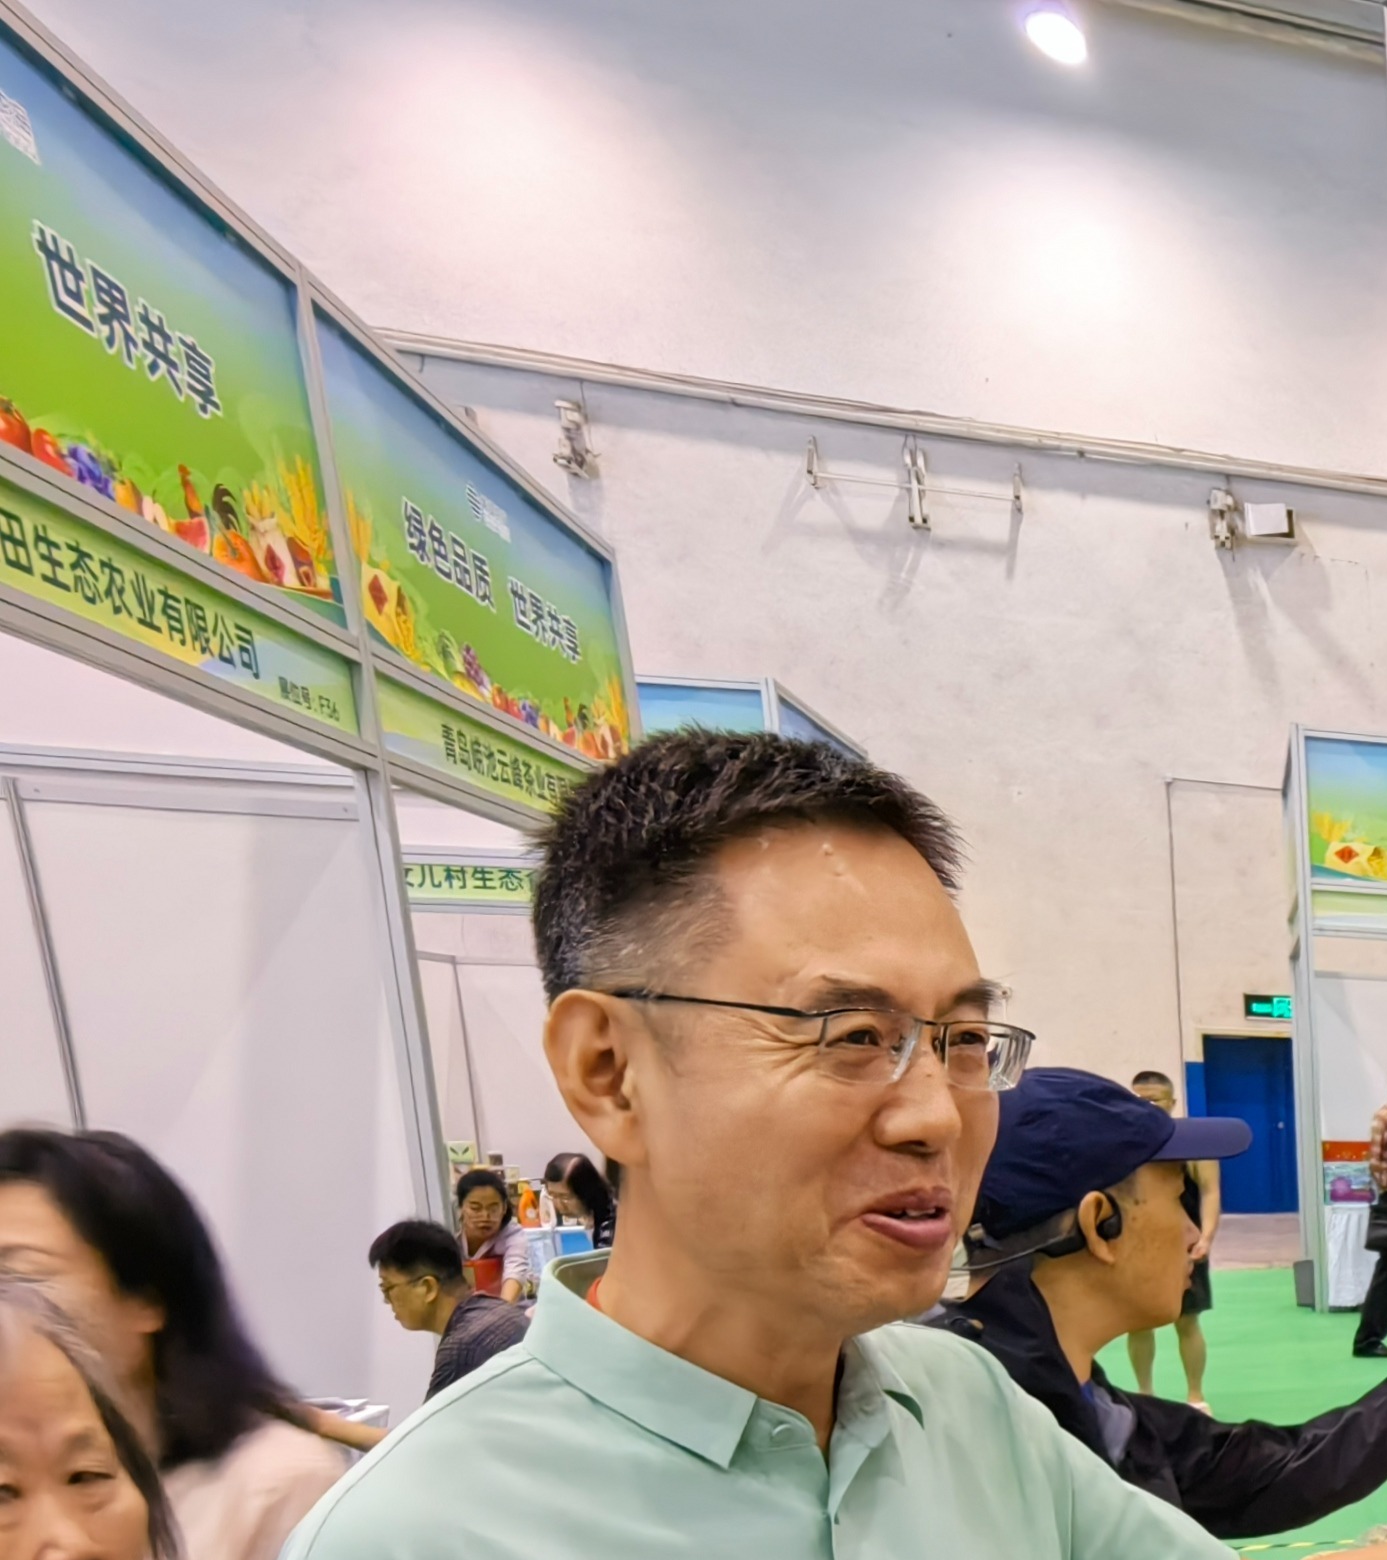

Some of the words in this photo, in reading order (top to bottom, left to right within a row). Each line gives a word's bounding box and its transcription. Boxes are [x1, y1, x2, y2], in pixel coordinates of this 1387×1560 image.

[32, 219, 223, 419] 世界共享
[0, 506, 261, 680] 田生态农业有限公司
[402, 496, 497, 613] 绿色品质
[508, 575, 583, 664] 世界共享
